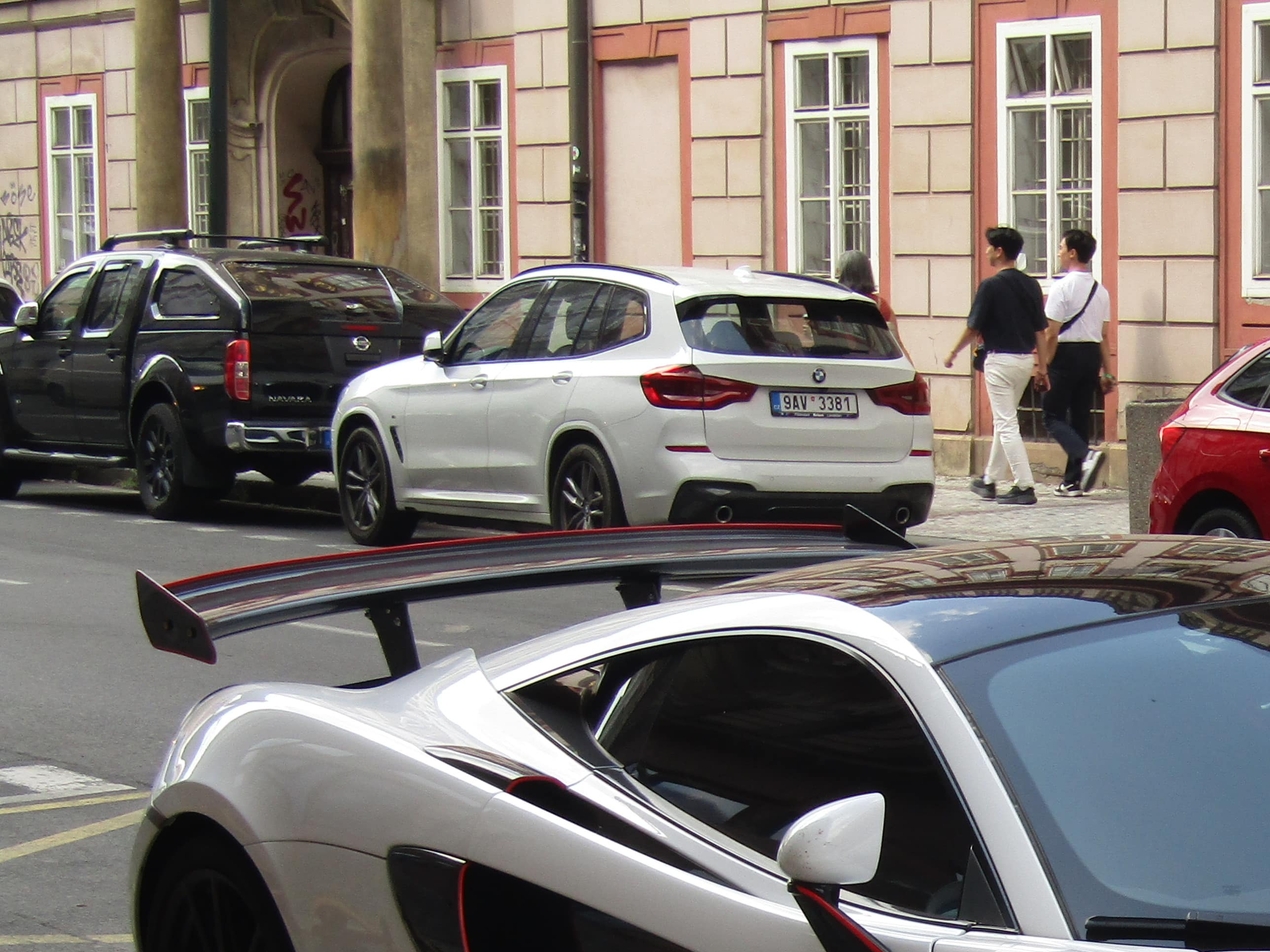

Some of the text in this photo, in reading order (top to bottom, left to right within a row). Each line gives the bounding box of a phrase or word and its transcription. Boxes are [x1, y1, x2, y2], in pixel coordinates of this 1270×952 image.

[268, 395, 312, 403] NAVARA
[783, 395, 807, 410] 9AV
[818, 396, 851, 411] 3381
